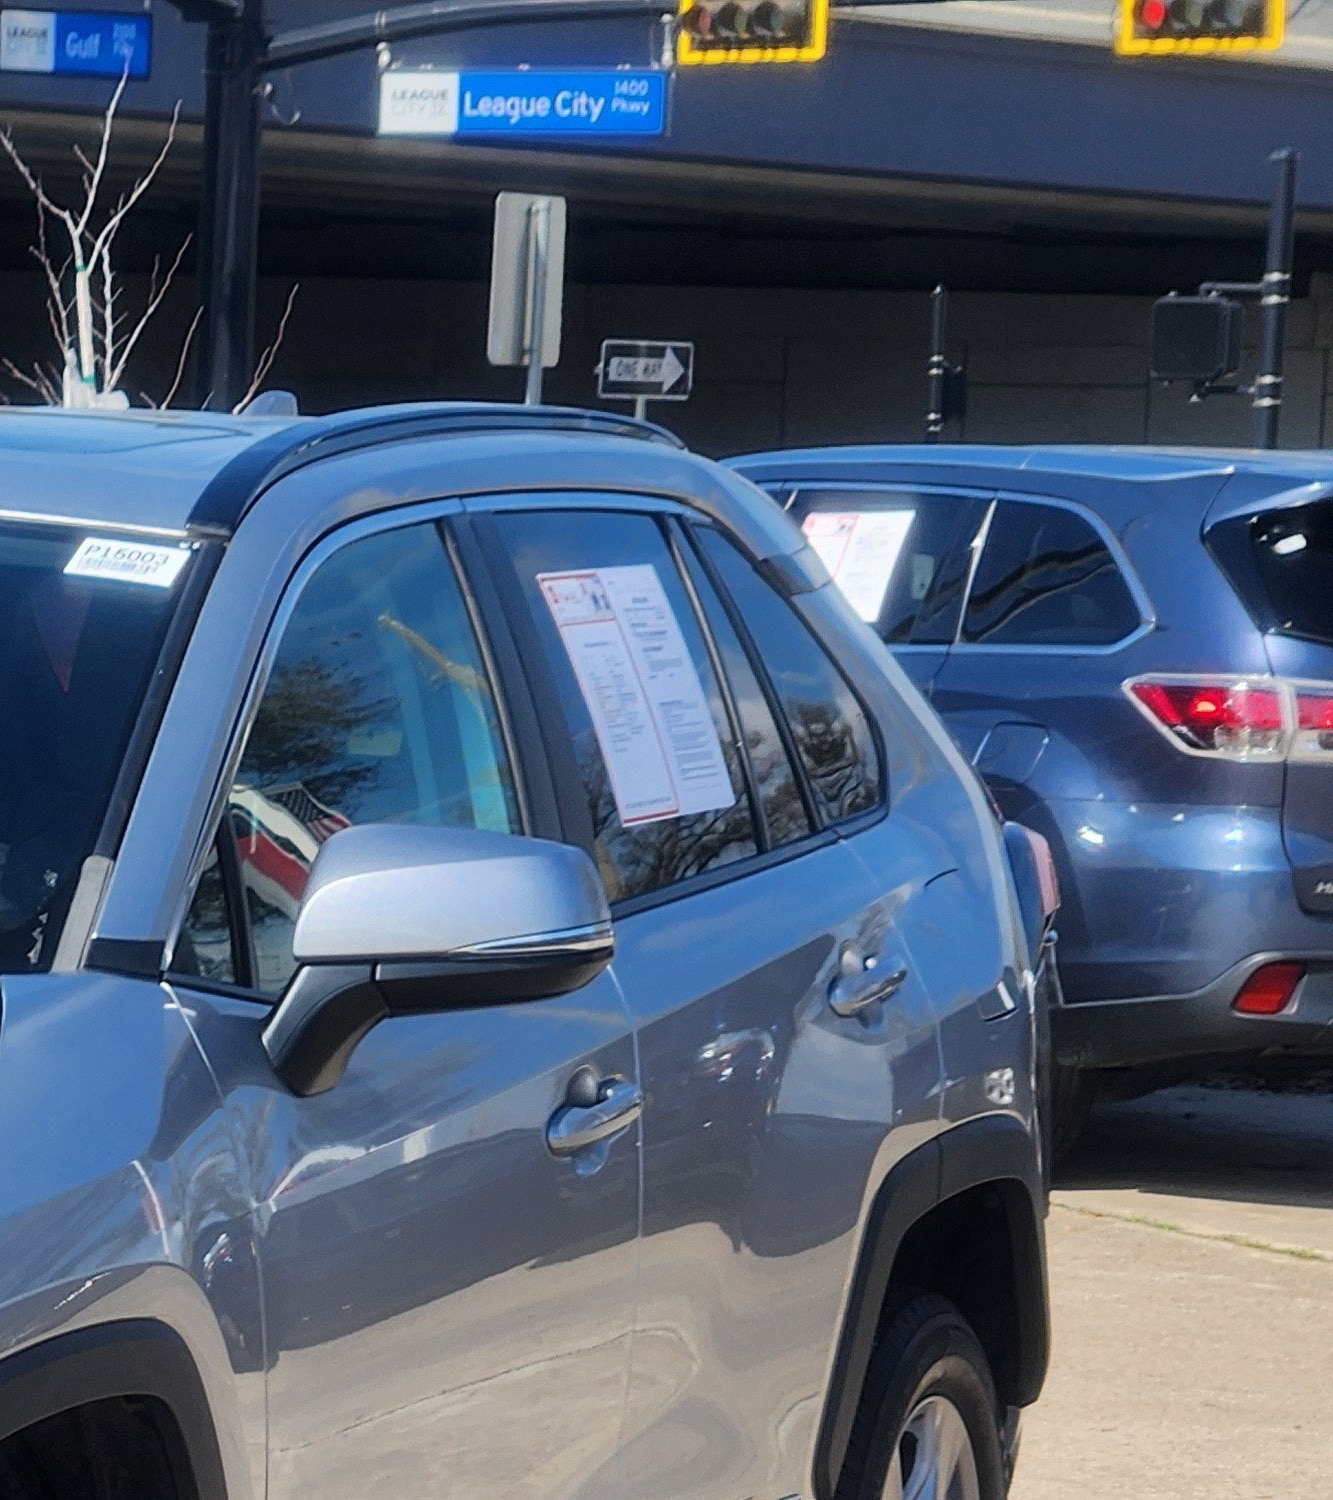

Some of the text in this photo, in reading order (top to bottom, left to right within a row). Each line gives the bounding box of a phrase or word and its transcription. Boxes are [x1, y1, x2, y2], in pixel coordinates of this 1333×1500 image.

[65, 30, 101, 59] Gulf
[391, 88, 449, 101] LEAGUE
[463, 89, 606, 125] League City
[611, 98, 651, 117] Pkwy
[616, 359, 663, 379] ONE WAY
